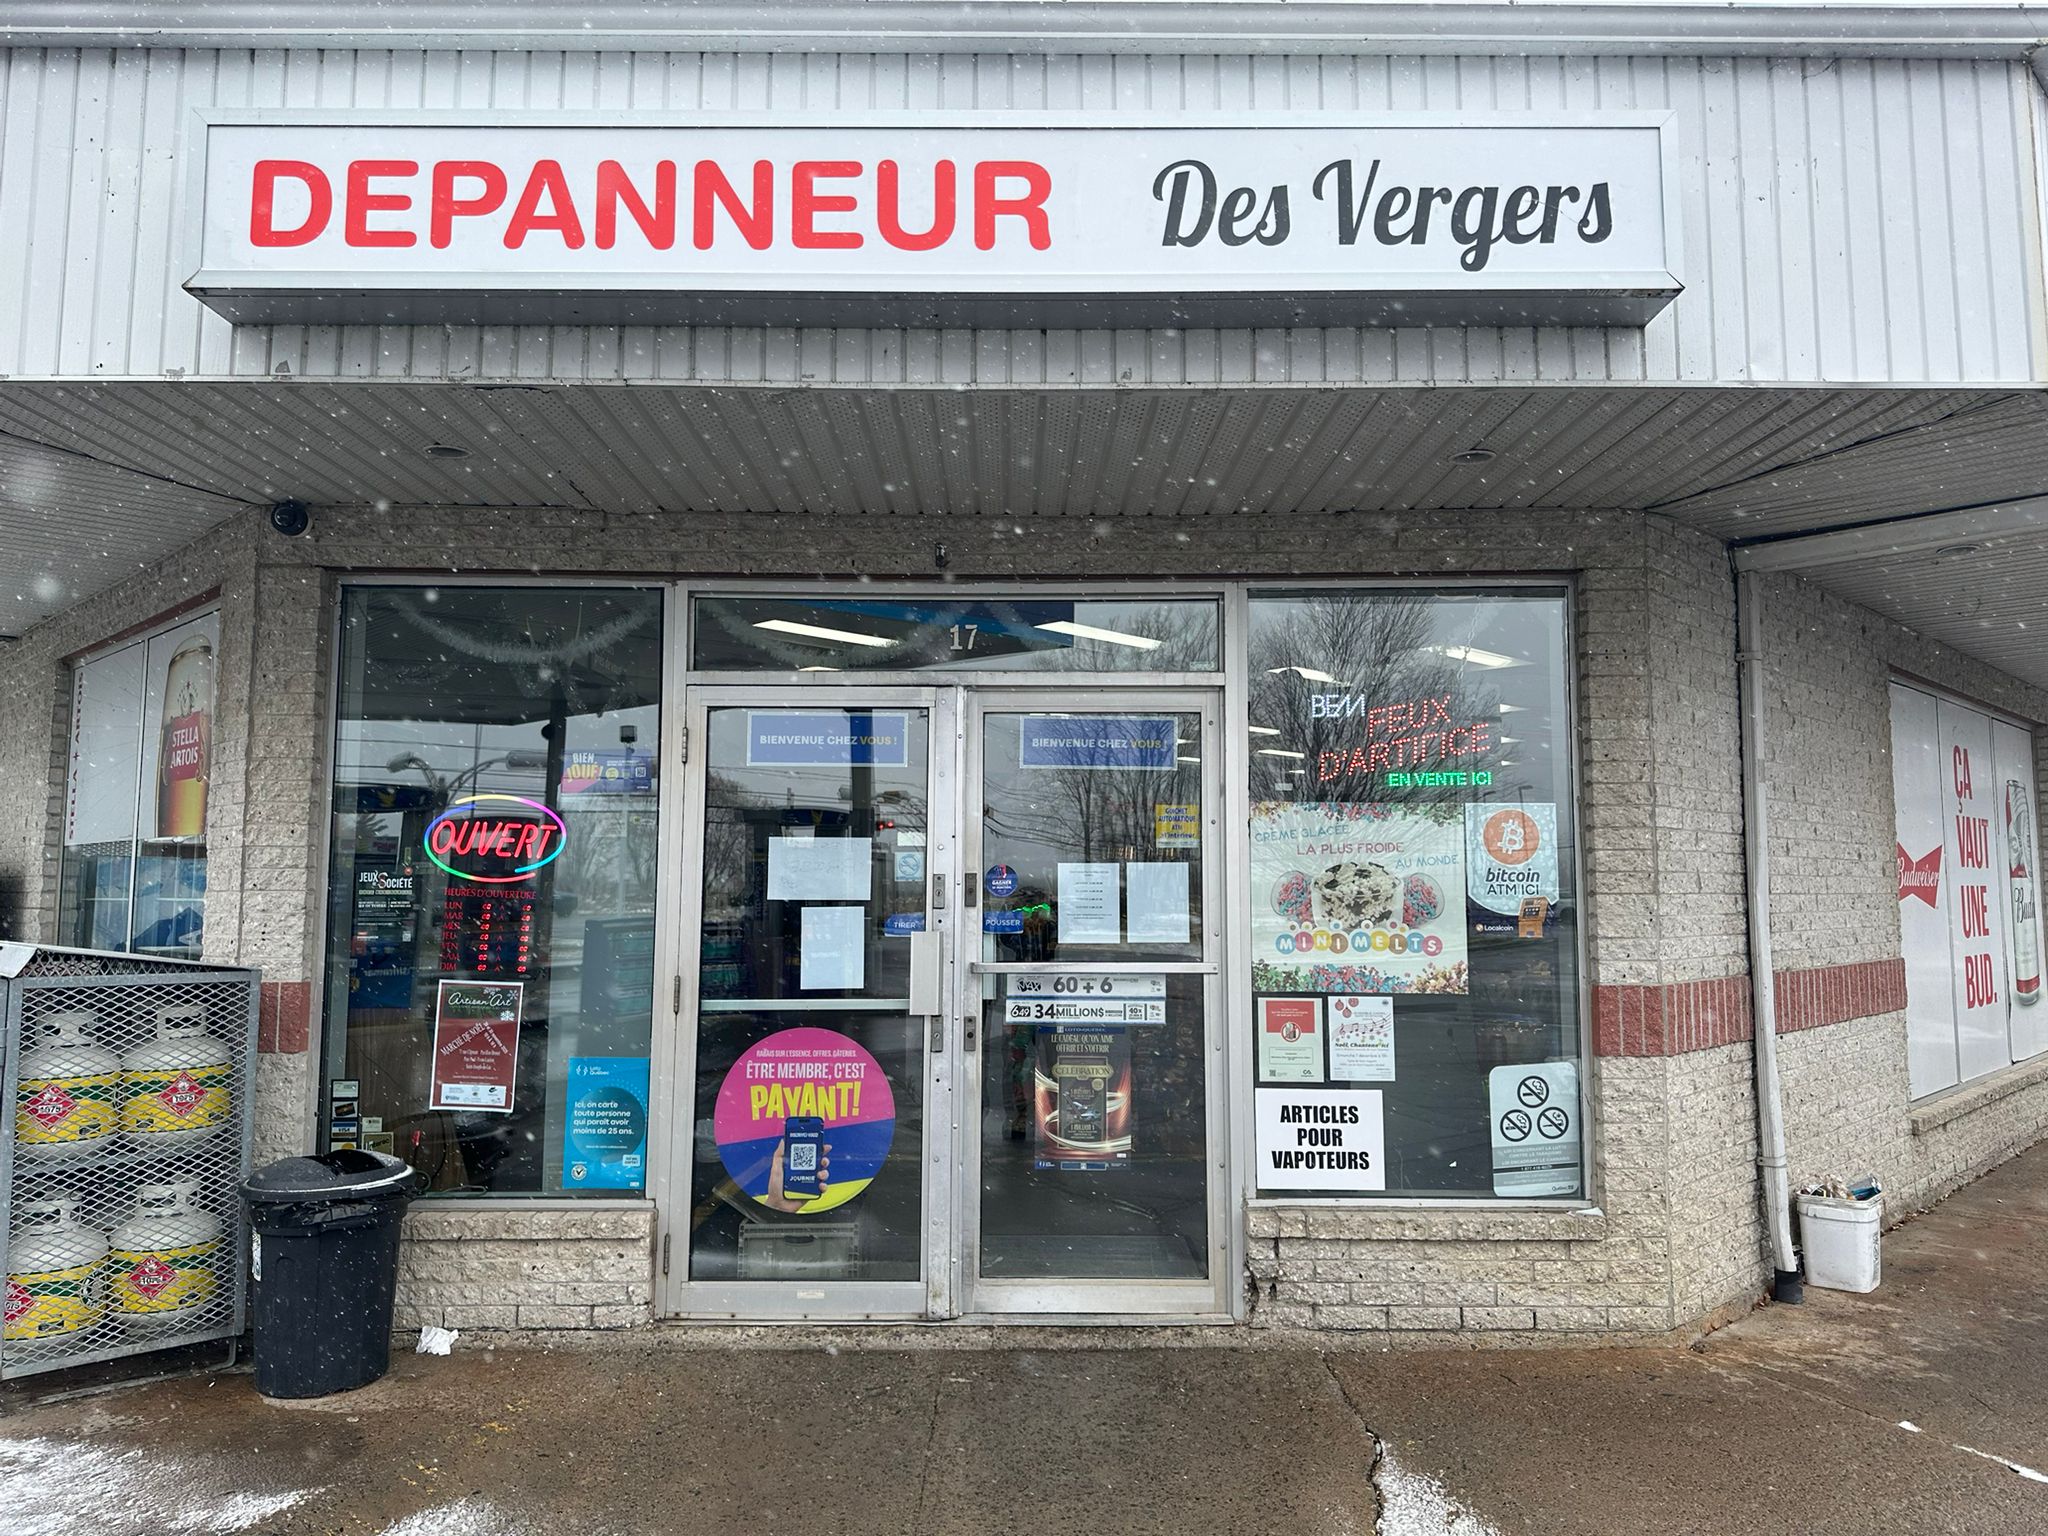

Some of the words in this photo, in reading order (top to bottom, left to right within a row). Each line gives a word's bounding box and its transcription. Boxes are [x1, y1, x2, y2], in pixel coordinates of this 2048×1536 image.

[250, 160, 1051, 250] DEPANNEUR
[1153, 159, 1291, 247] Des
[1312, 159, 1614, 271] Vergers
[950, 624, 978, 650] 17
[1368, 695, 1451, 737] FEUX
[172, 726, 199, 748] STELLA
[760, 735, 824, 745] BIENVENUE
[827, 735, 857, 745] CHEZ
[860, 736, 891, 745] VOUS
[1032, 739, 1095, 748] BIENVENUE
[1098, 739, 1128, 749] CHEZ
[1130, 739, 1162, 749] VOUS
[170, 747, 198, 768] ARTOIS
[1388, 773, 1411, 786] EN
[1414, 772, 1467, 786] VENTE
[1472, 771, 1492, 785] ICI
[1953, 745, 1972, 813] ÇA
[432, 819, 557, 859] OUVERT
[1297, 840, 1317, 855] LA
[1321, 842, 1353, 854] PLUS
[1357, 842, 1405, 853] FROIDE
[1956, 816, 1989, 869] VAUT
[1395, 860, 1413, 869] AU
[1416, 855, 1459, 867] MONDE
[359, 871, 378, 883] JEUX
[378, 872, 413, 888] SOCIÉTÉ
[1486, 868, 1540, 882] bitcoin
[1898, 856, 1939, 889] Budweiser
[444, 888, 476, 897] HEURES
[476, 889, 536, 899] D'OUVERTURE
[1487, 884, 1516, 895] ATM
[1522, 884, 1539, 895] ICI
[1961, 885, 1989, 938] UNE
[1484, 924, 1513, 932] Localcoin
[1277, 931, 1346, 952] MINI
[1353, 932, 1440, 953] MELTS
[1053, 976, 1078, 993] 60
[1083, 982, 1094, 993] +
[1100, 977, 1113, 993] 6
[1965, 953, 1997, 1009] BUD.
[1034, 1004, 1056, 1019] 34
[746, 1060, 775, 1079] ÊTRE
[777, 1063, 831, 1080] MEMBRE,
[834, 1063, 866, 1079] C'EST
[751, 1081, 861, 1121] PAYANT!
[573, 1118, 586, 1126] qui
[1280, 1105, 1359, 1124] ARTICLES
[1297, 1128, 1343, 1147] POUR
[1272, 1151, 1370, 1170] VAPOTEURS
